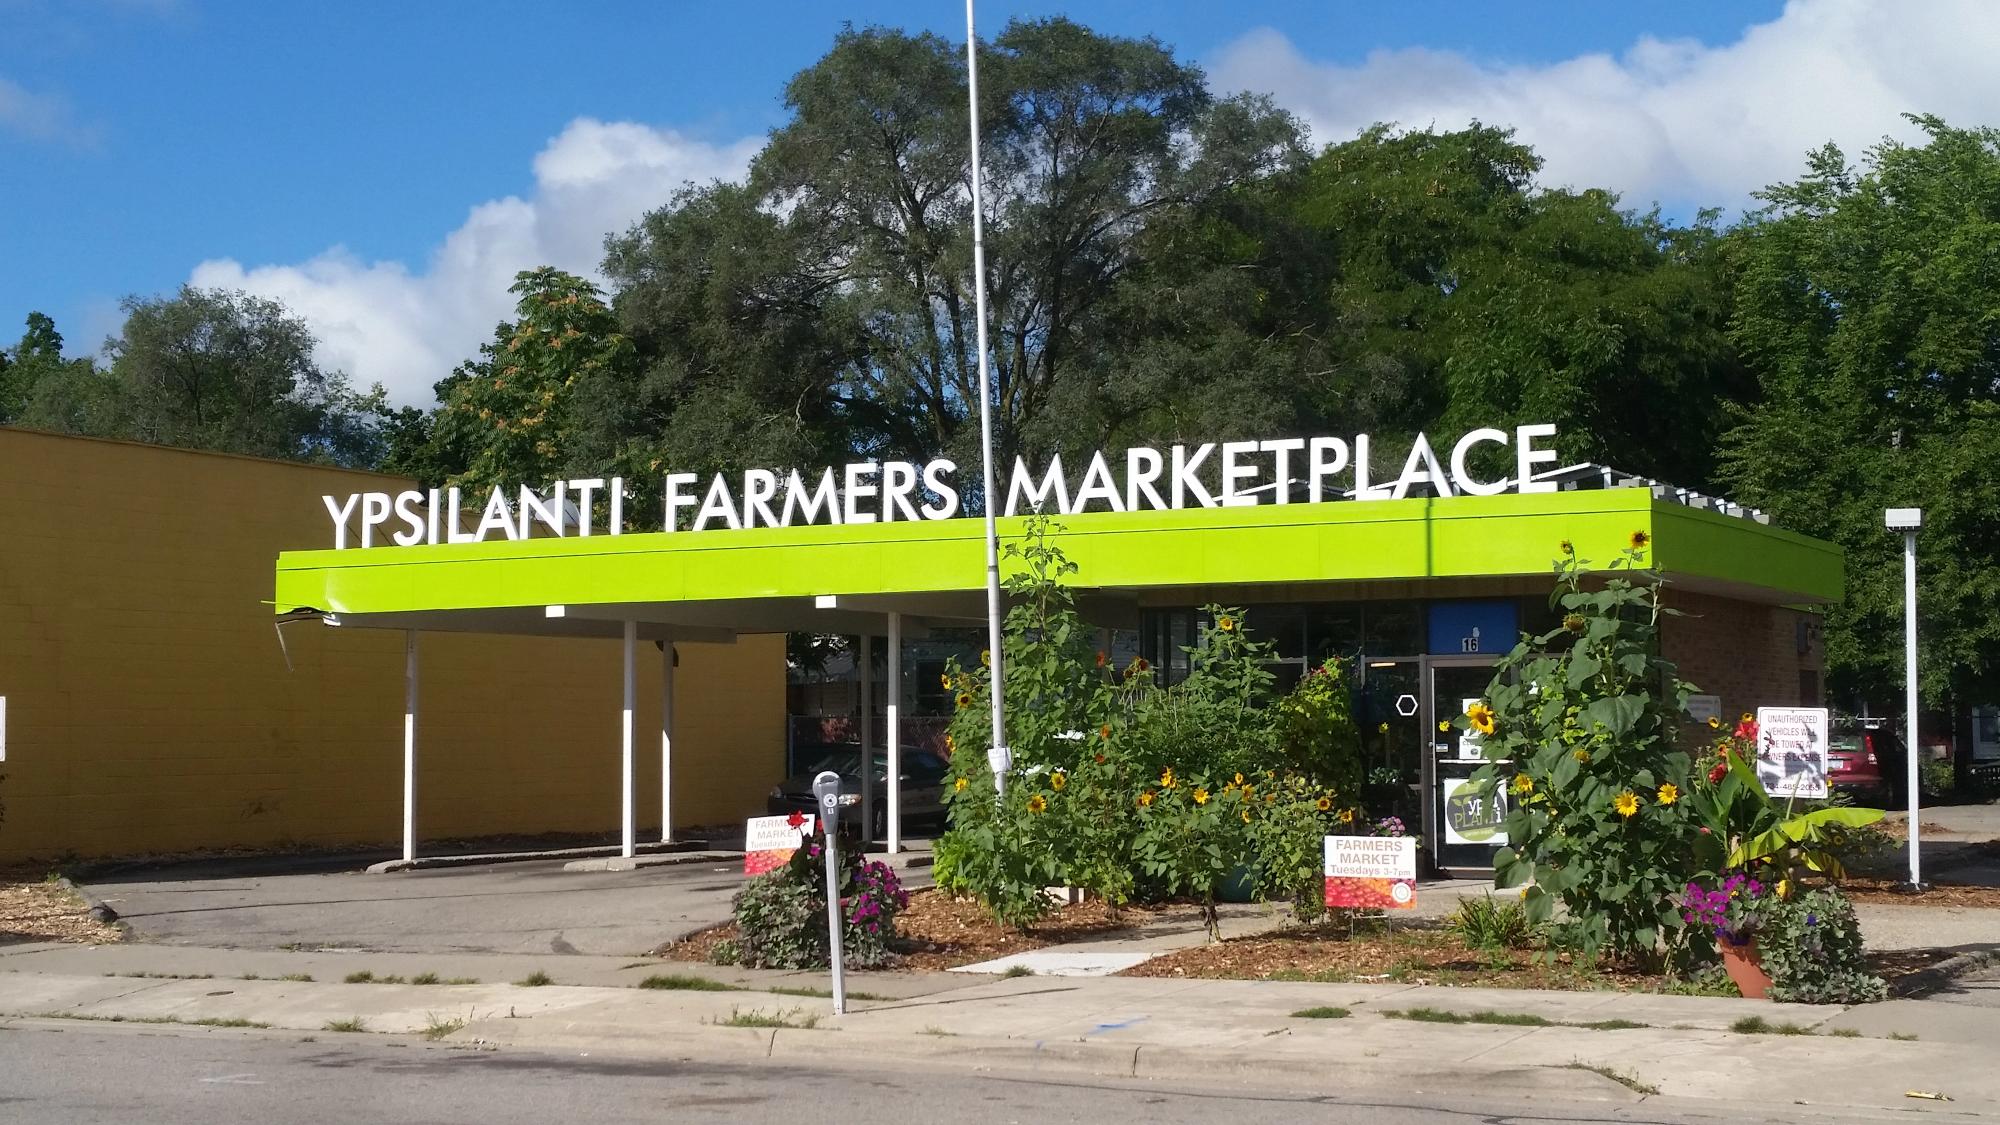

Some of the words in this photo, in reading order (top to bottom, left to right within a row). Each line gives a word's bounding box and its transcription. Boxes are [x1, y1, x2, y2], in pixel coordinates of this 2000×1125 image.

[322, 475, 622, 549] YPSILANTI
[664, 458, 959, 532] FARMERS
[1003, 423, 1558, 517] MARKETPLACE
[1463, 638, 1477, 651] 16
[1767, 714, 1818, 723] UNAUTHORIZED
[1768, 727, 1800, 736] VEHICLES
[757, 829, 799, 839] MARKET
[1336, 840, 1403, 852] FARMERS
[1340, 853, 1400, 865] MARKET
[1330, 865, 1380, 876] Tuesdays
[1383, 868, 1411, 877] 3-7pm
